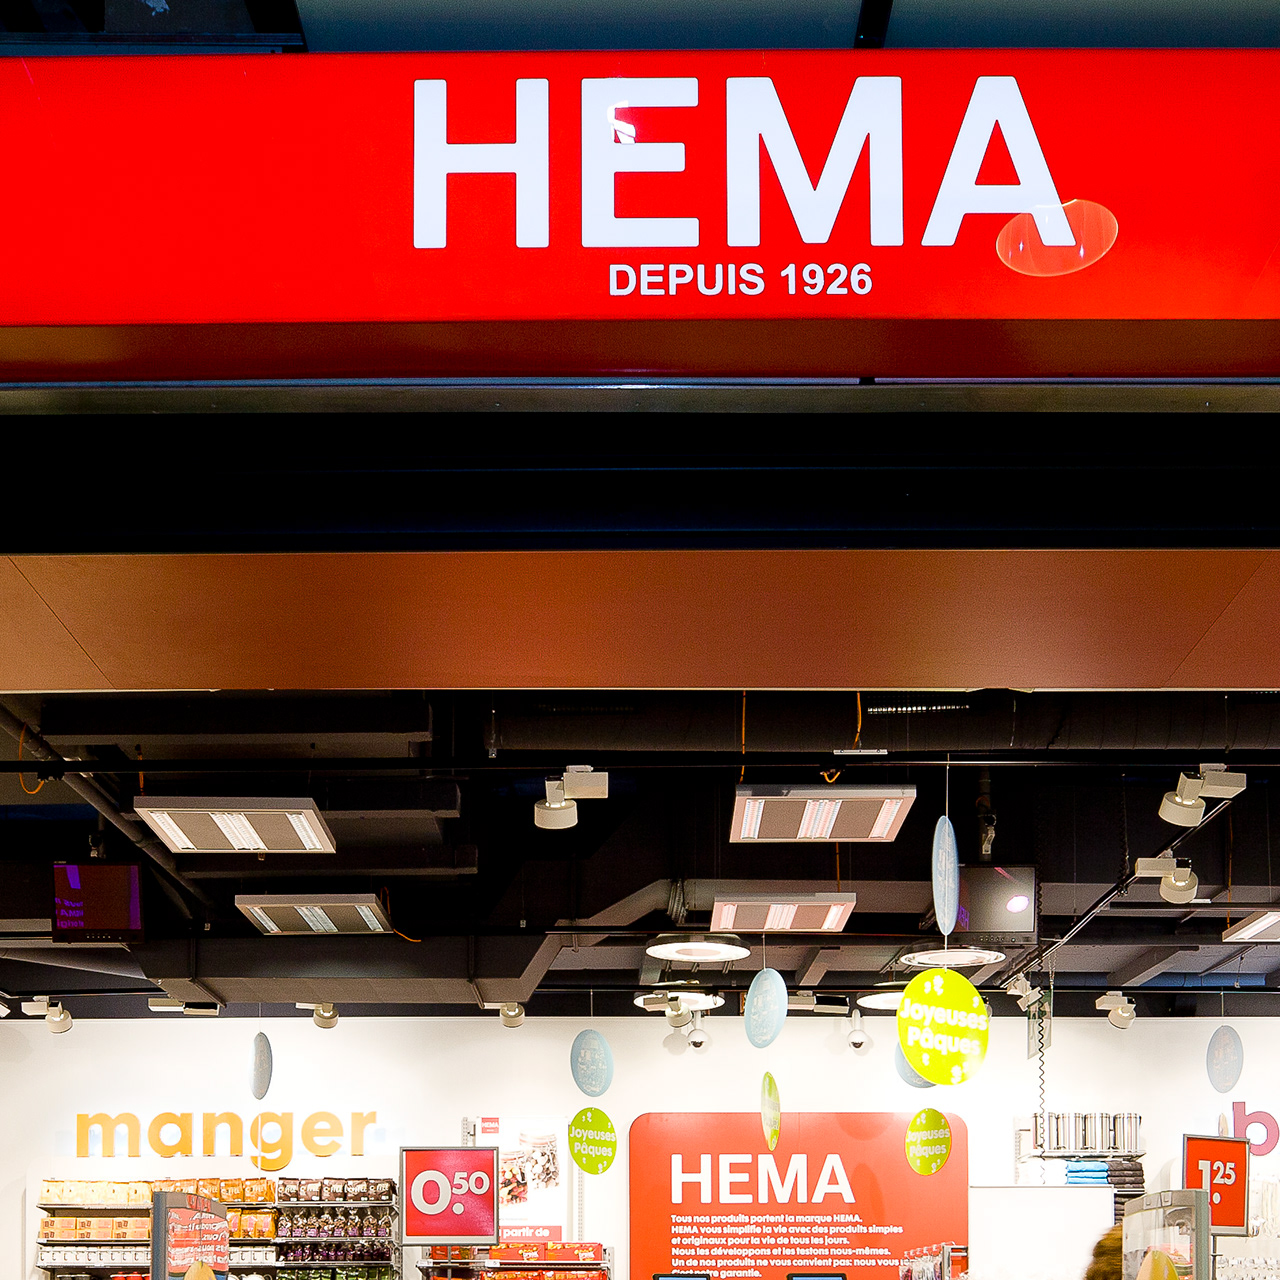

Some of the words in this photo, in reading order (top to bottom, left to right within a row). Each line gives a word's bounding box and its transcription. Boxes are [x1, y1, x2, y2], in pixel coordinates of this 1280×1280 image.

[413, 76, 1076, 248] HEMA
[609, 263, 765, 296] DEPUIS
[780, 263, 872, 296] 1926
[900, 998, 988, 1031] Joyeuses
[907, 1026, 980, 1056] Pâques
[76, 1111, 377, 1171] manger
[570, 1125, 616, 1142] Joyeuses
[906, 1129, 950, 1144] Joyeuses
[574, 1141, 613, 1158] Pâques
[910, 1144, 947, 1158] Pâques
[671, 1153, 856, 1204] HEMA
[671, 1214, 692, 1223] Tous
[710, 1214, 749, 1225] produits
[750, 1214, 784, 1224] portent
[785, 1214, 795, 1223] la
[795, 1215, 832, 1224] marque
[833, 1214, 863, 1223] HEMA.
[503, 1227, 534, 1239] partir
[535, 1227, 550, 1237] de
[671, 1225, 699, 1234] HEMA
[700, 1226, 722, 1234] vous
[723, 1225, 762, 1235] simplifie
[763, 1225, 772, 1234] la
[773, 1225, 787, 1233] vie
[788, 1226, 811, 1234] avec
[812, 1225, 828, 1234] des
[829, 1224, 868, 1235] produits
[868, 1225, 903, 1235] simples
[671, 1236, 681, 1245] et
[681, 1236, 727, 1246] originaux
[727, 1237, 750, 1246] pour
[750, 1236, 761, 1245] la
[761, 1236, 775, 1244] vie
[777, 1236, 789, 1244] de
[790, 1236, 810, 1244] tous
[811, 1236, 824, 1244] les
[824, 1236, 850, 1246] jours.
[671, 1247, 695, 1255] Nous
[696, 1247, 710, 1255] les
[710, 1246, 771, 1257] développons
[771, 1247, 782, 1255] et
[782, 1247, 796, 1255] les
[796, 1247, 829, 1255] testons
[830, 1246, 891, 1256] nous-mêmes.
[671, 1258, 685, 1266] Un
[685, 1258, 698, 1266] de
[716, 1257, 756, 1268] produits
[792, 1258, 832, 1267] convient
[833, 1259, 852, 1268] pas:
[853, 1259, 876, 1267] nous
[877, 1259, 899, 1267] vous
[720, 1268, 762, 1279] garantie.
